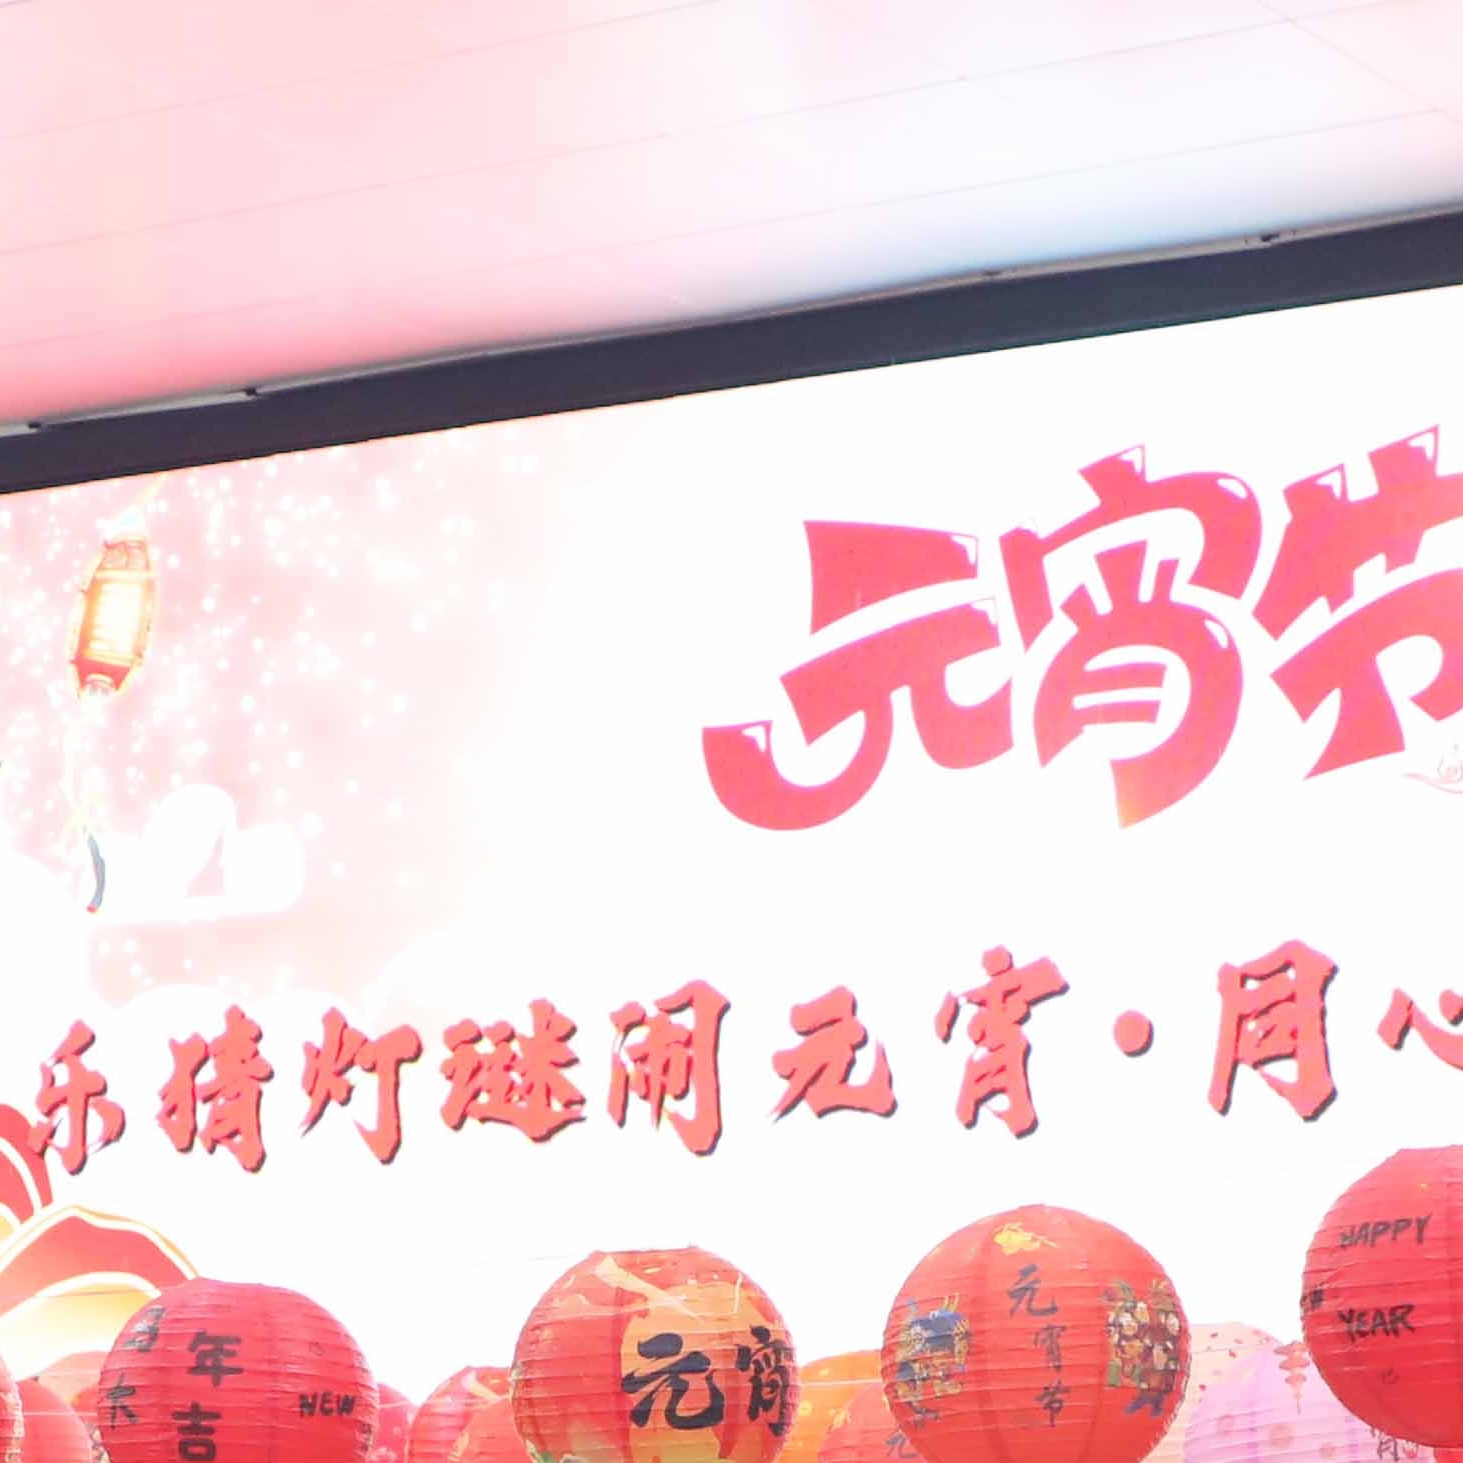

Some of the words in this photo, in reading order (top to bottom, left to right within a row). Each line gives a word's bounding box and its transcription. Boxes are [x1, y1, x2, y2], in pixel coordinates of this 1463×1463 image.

[1338, 1213, 1432, 1249] HAPPY
[1338, 1303, 1417, 1342] YEAR
[1007, 1264, 1069, 1428] 元宵节
[621, 1325, 794, 1437] 元宵
[299, 1391, 356, 1417] NEW
